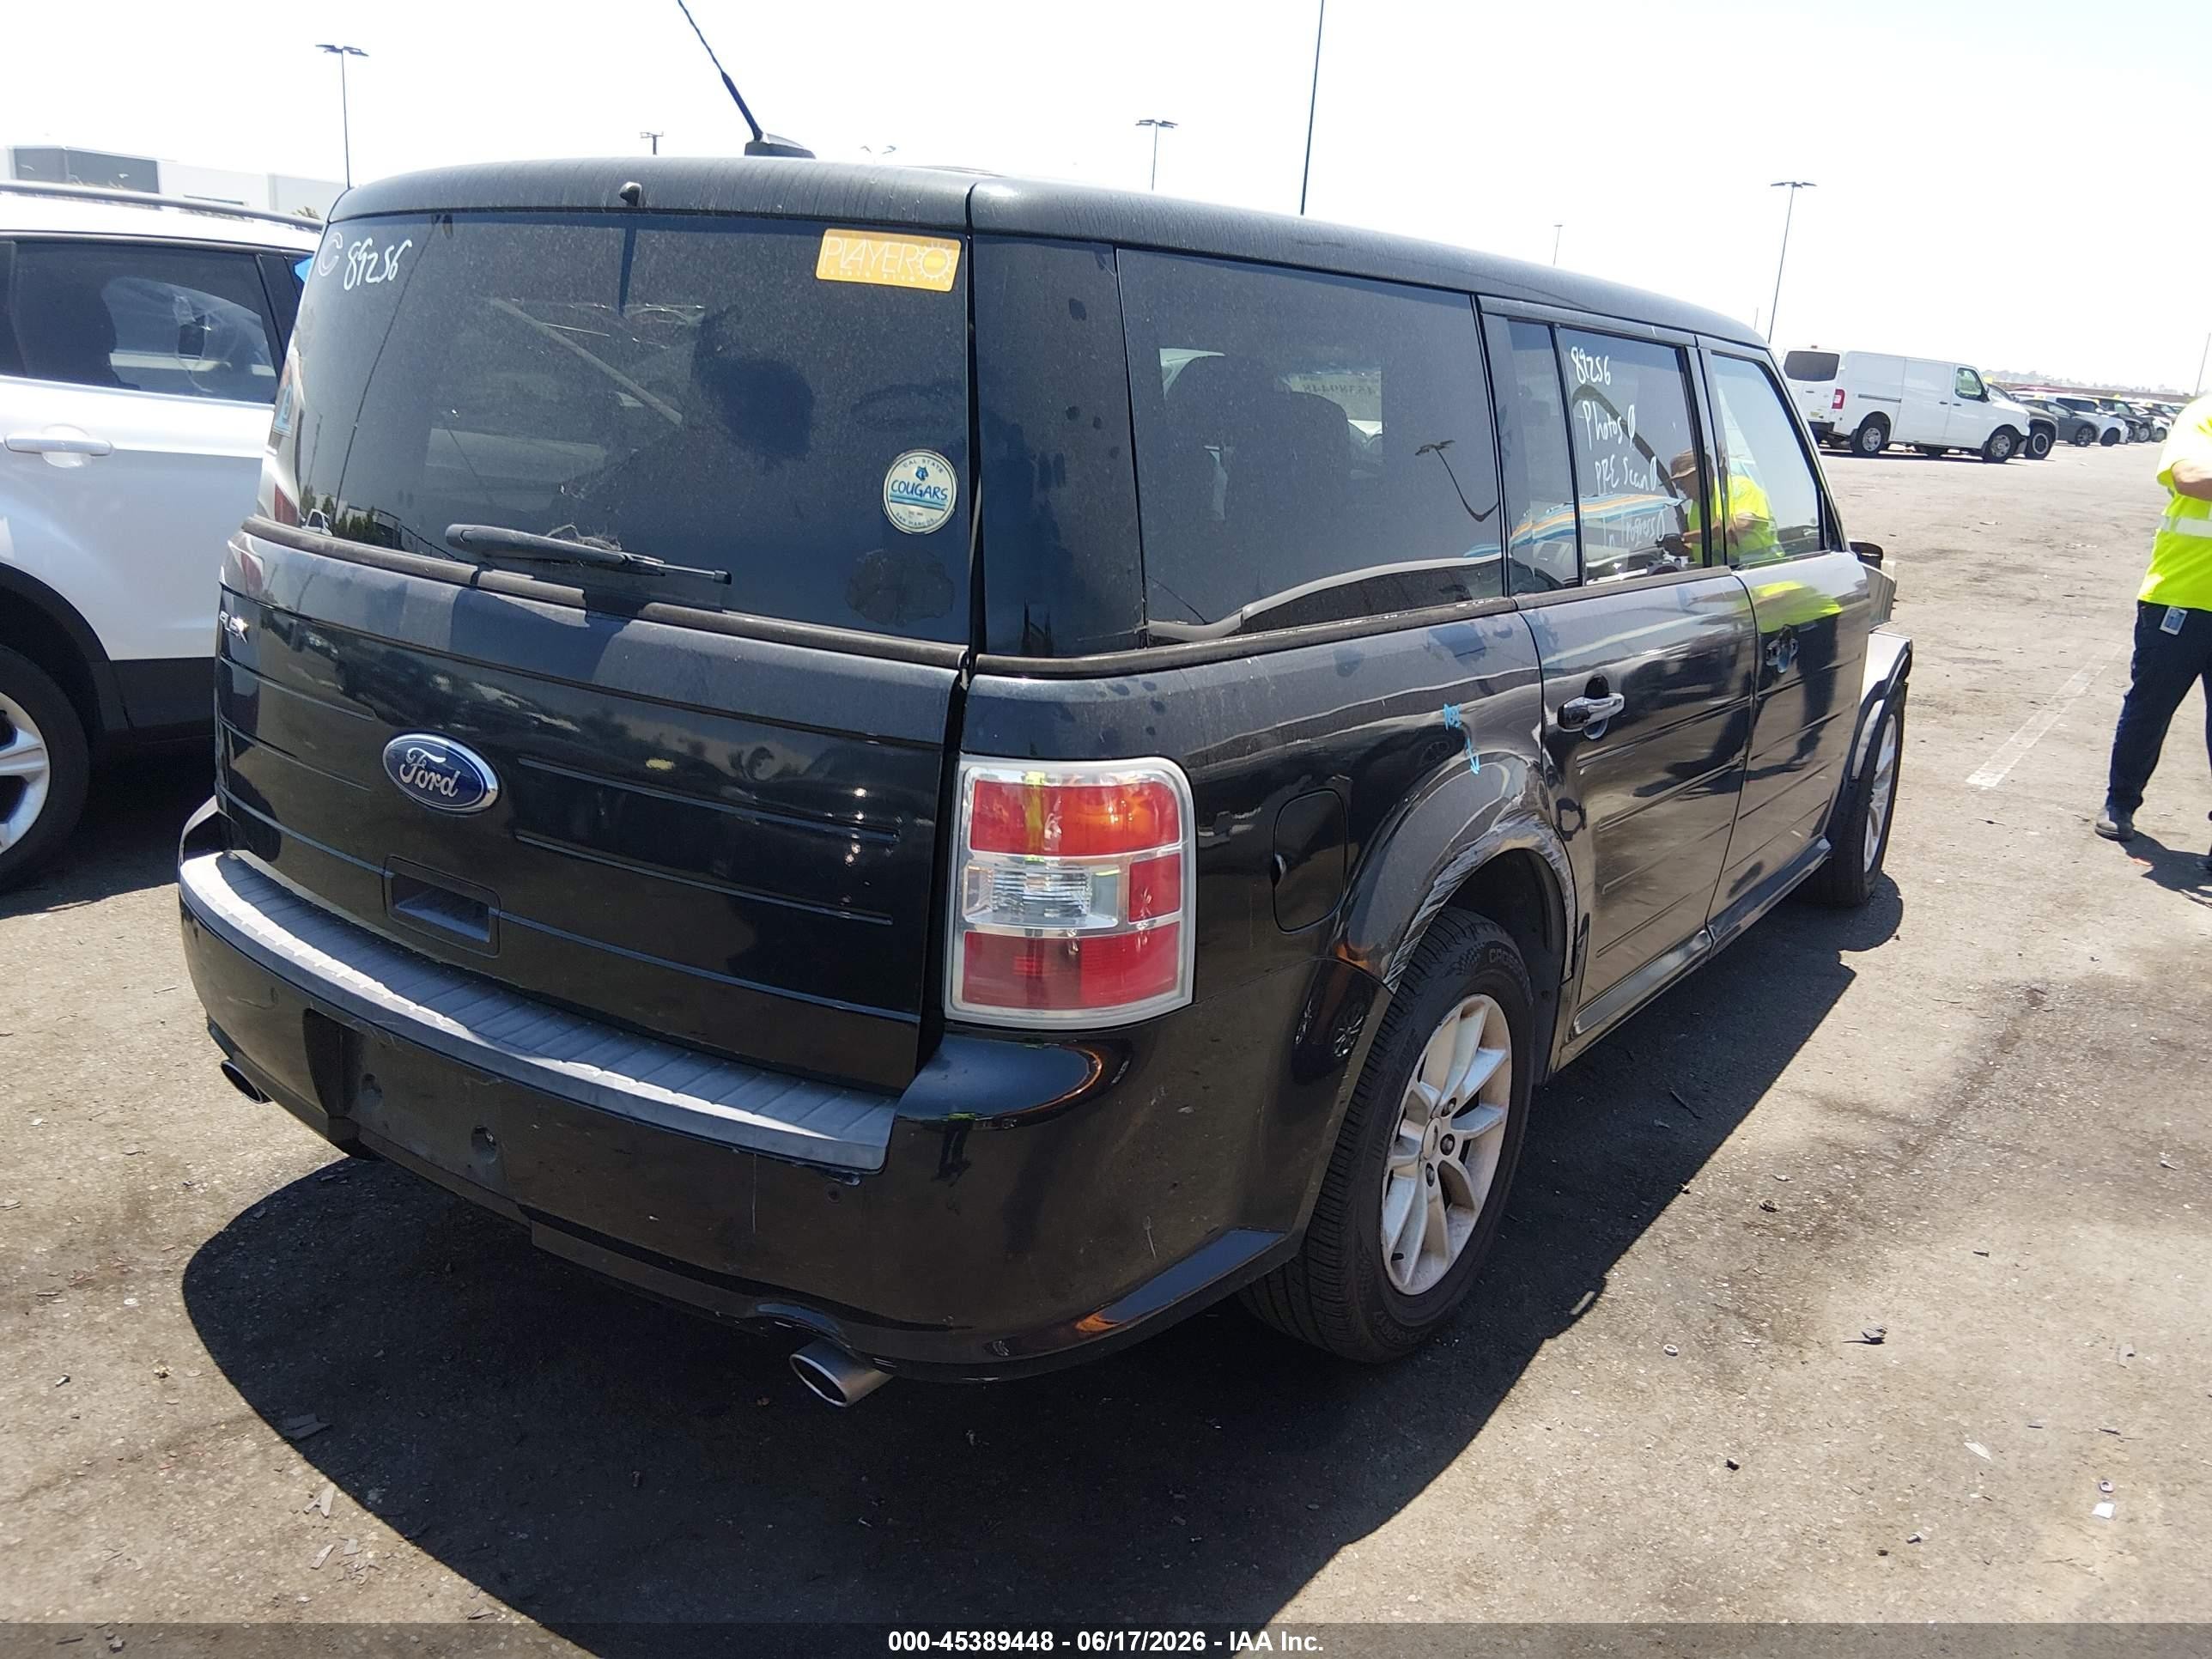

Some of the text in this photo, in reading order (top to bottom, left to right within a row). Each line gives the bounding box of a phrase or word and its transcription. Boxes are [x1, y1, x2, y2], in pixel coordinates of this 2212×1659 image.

[343, 237, 413, 291] 89256
[1571, 347, 1611, 385] 89256
[1582, 399, 1623, 451] Photos
[891, 480, 948, 500] COUGARS
[399, 747, 461, 797] Ford
